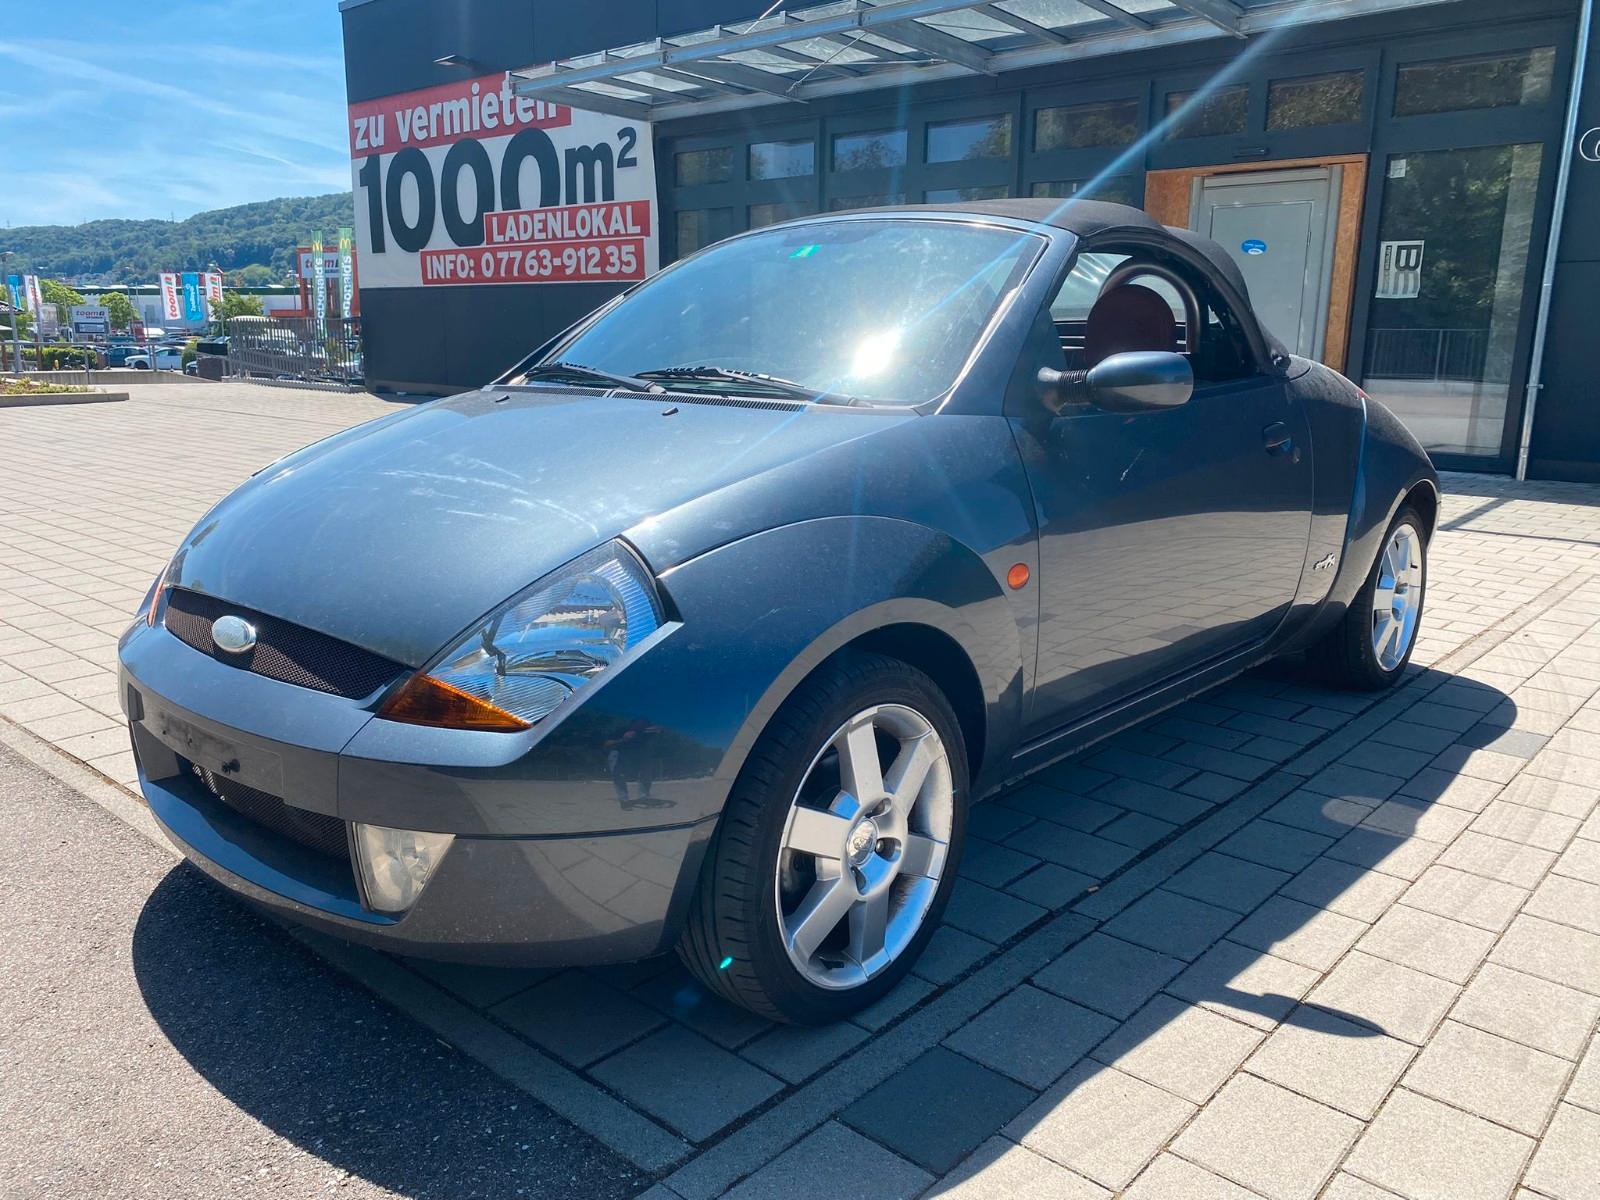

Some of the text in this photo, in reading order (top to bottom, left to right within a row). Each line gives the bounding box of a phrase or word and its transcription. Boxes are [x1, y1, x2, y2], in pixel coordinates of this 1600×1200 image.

[353, 113, 385, 151] zu
[491, 205, 641, 243] LADENLOKAL
[426, 252, 476, 280] INFO:
[166, 286, 178, 318] toom
